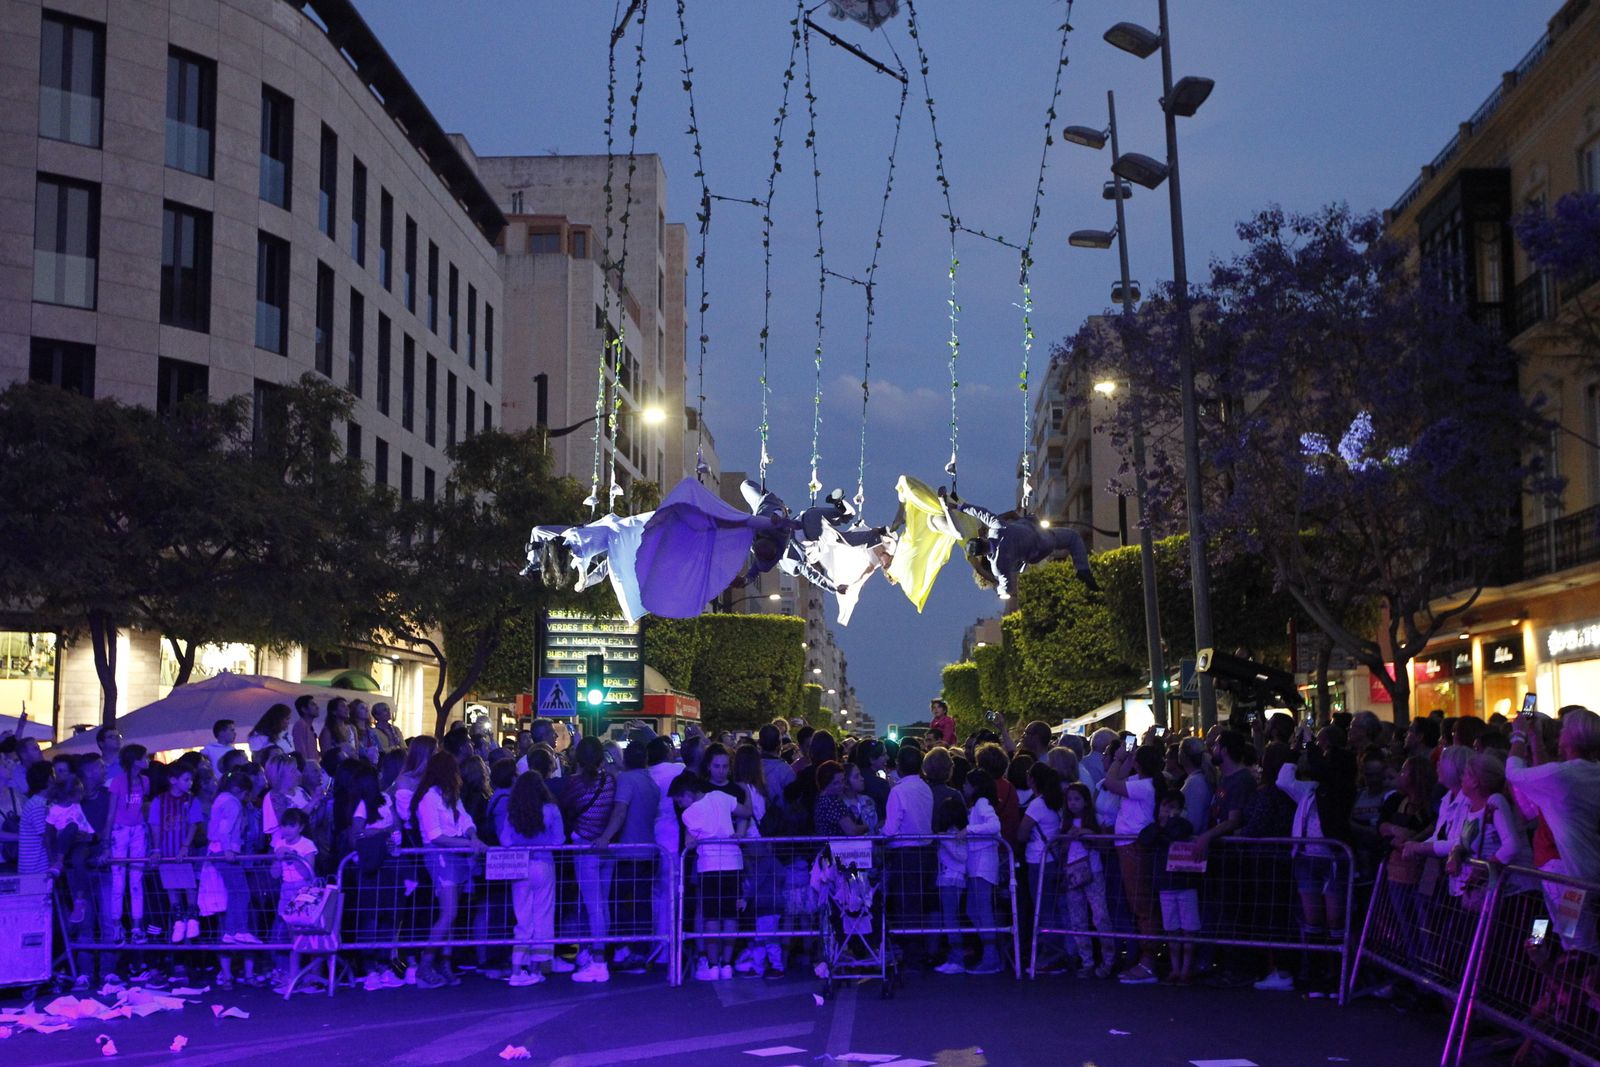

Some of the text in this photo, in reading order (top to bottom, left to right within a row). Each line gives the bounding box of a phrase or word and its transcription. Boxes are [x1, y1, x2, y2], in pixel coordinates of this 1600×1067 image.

[547, 624, 578, 632] VERDES
[582, 624, 593, 632] ES
[556, 637, 635, 646] LA NATURALEZA Y
[547, 650, 568, 658] BUEN
[613, 651, 624, 660] DE
[628, 651, 640, 660] LA
[628, 678, 639, 687] DE
